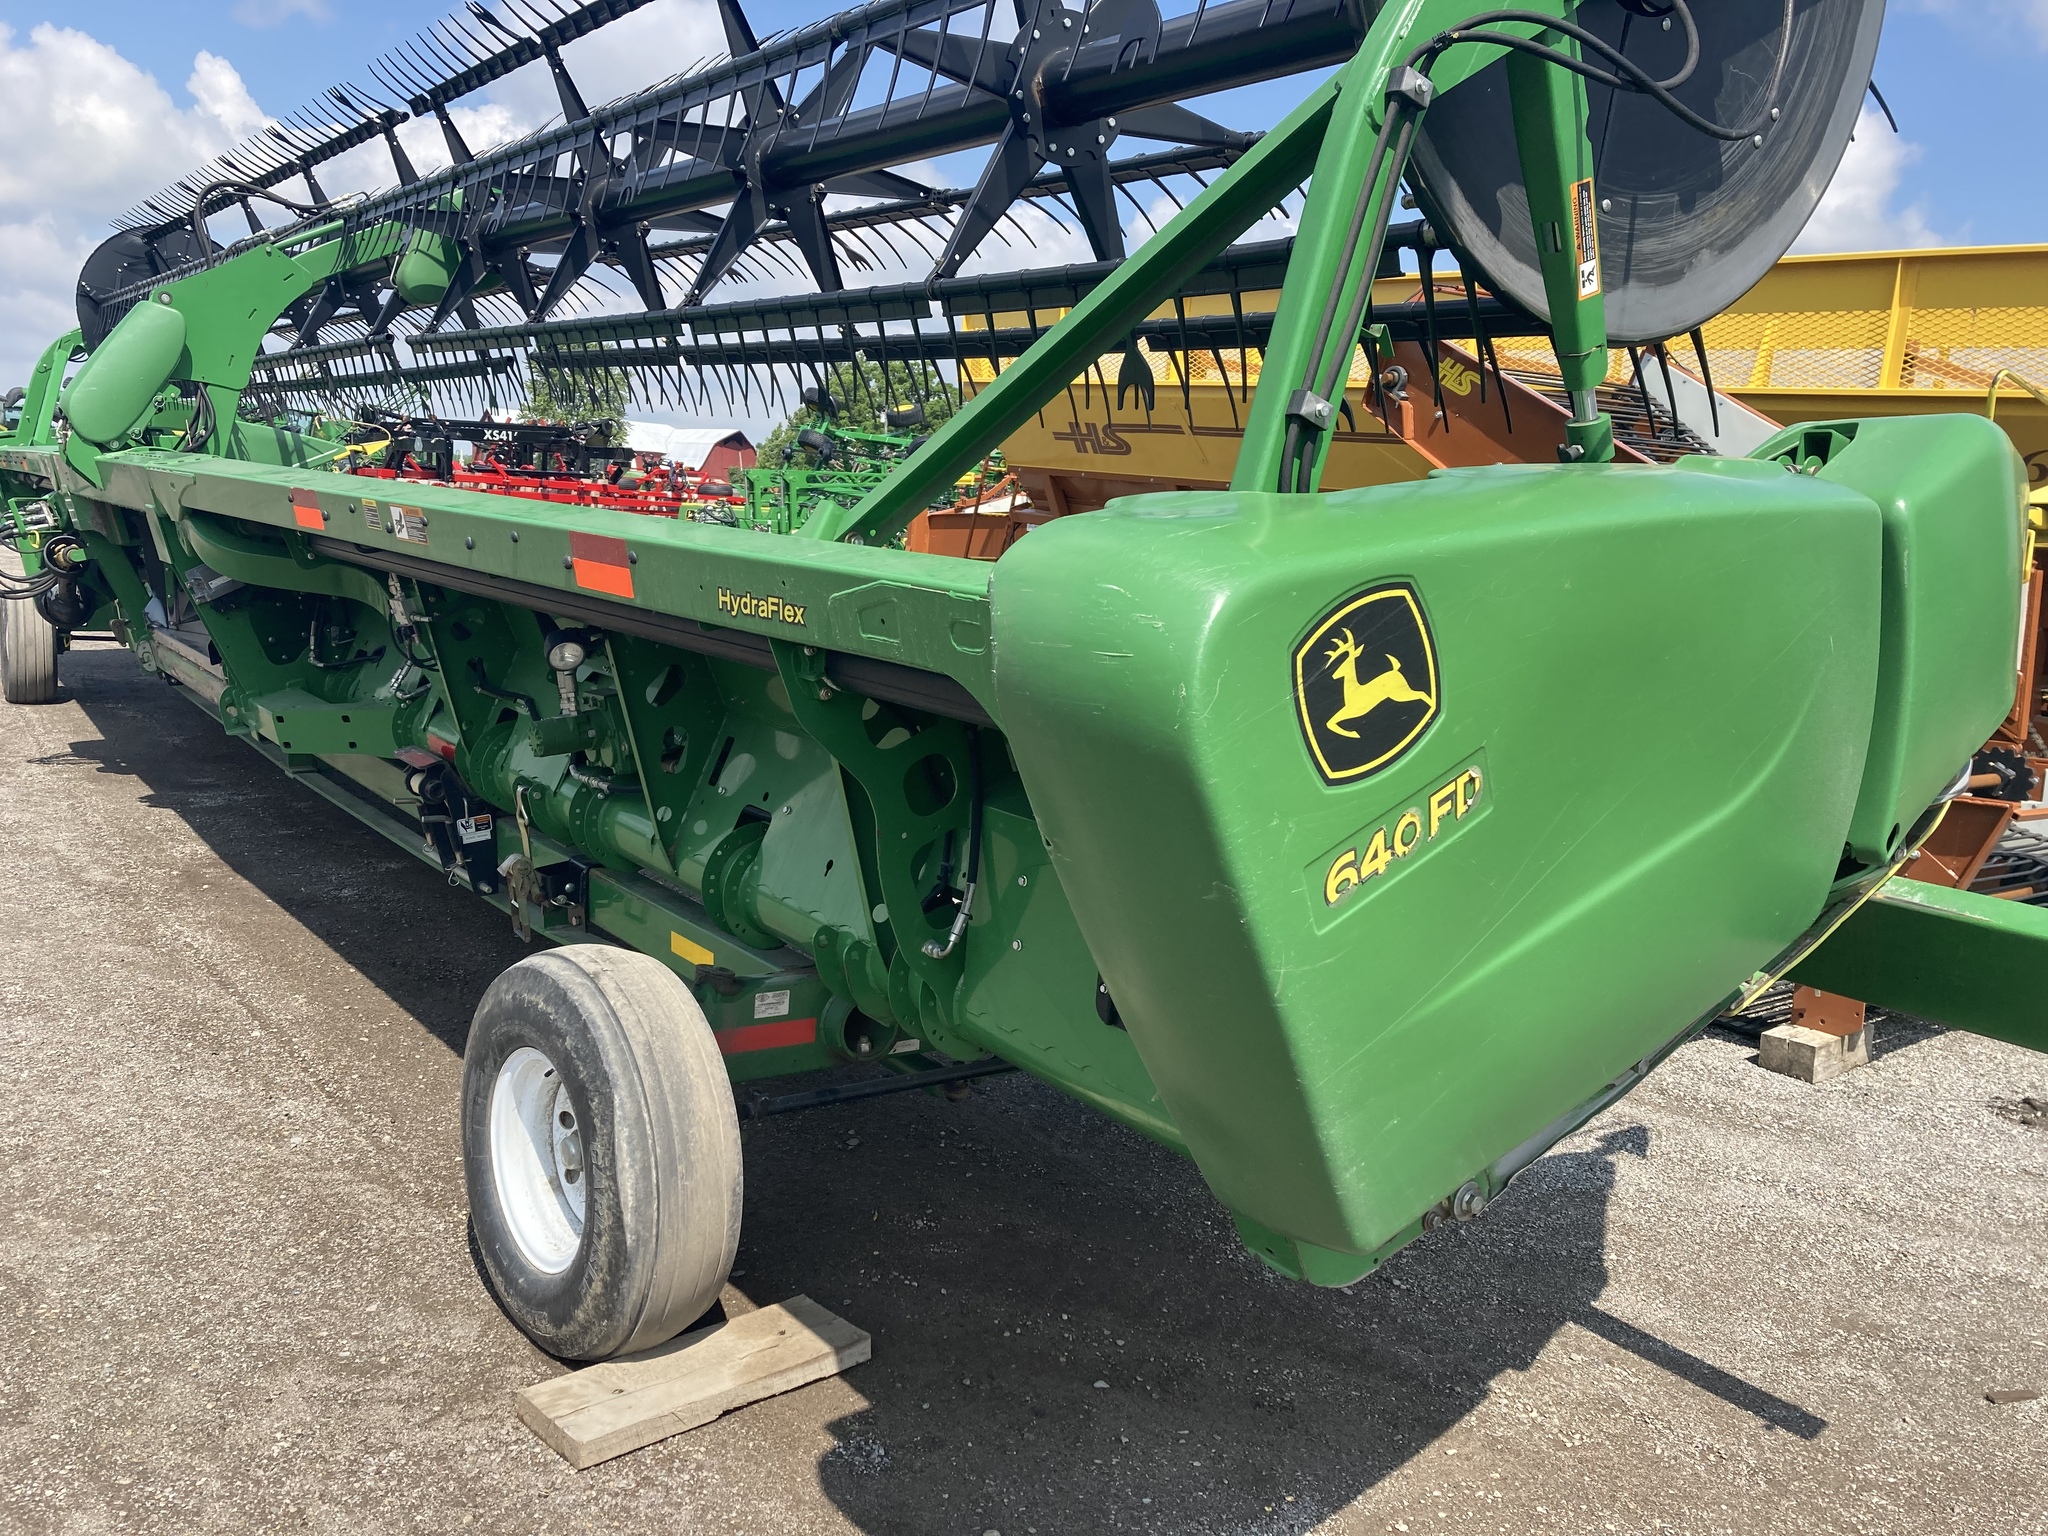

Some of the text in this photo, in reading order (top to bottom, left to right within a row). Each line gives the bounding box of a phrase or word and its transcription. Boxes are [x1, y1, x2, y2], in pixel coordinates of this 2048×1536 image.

[1572, 196, 1581, 240] WARNING
[717, 586, 807, 626] HydraFlex
[1325, 767, 1482, 907] 640 FD
